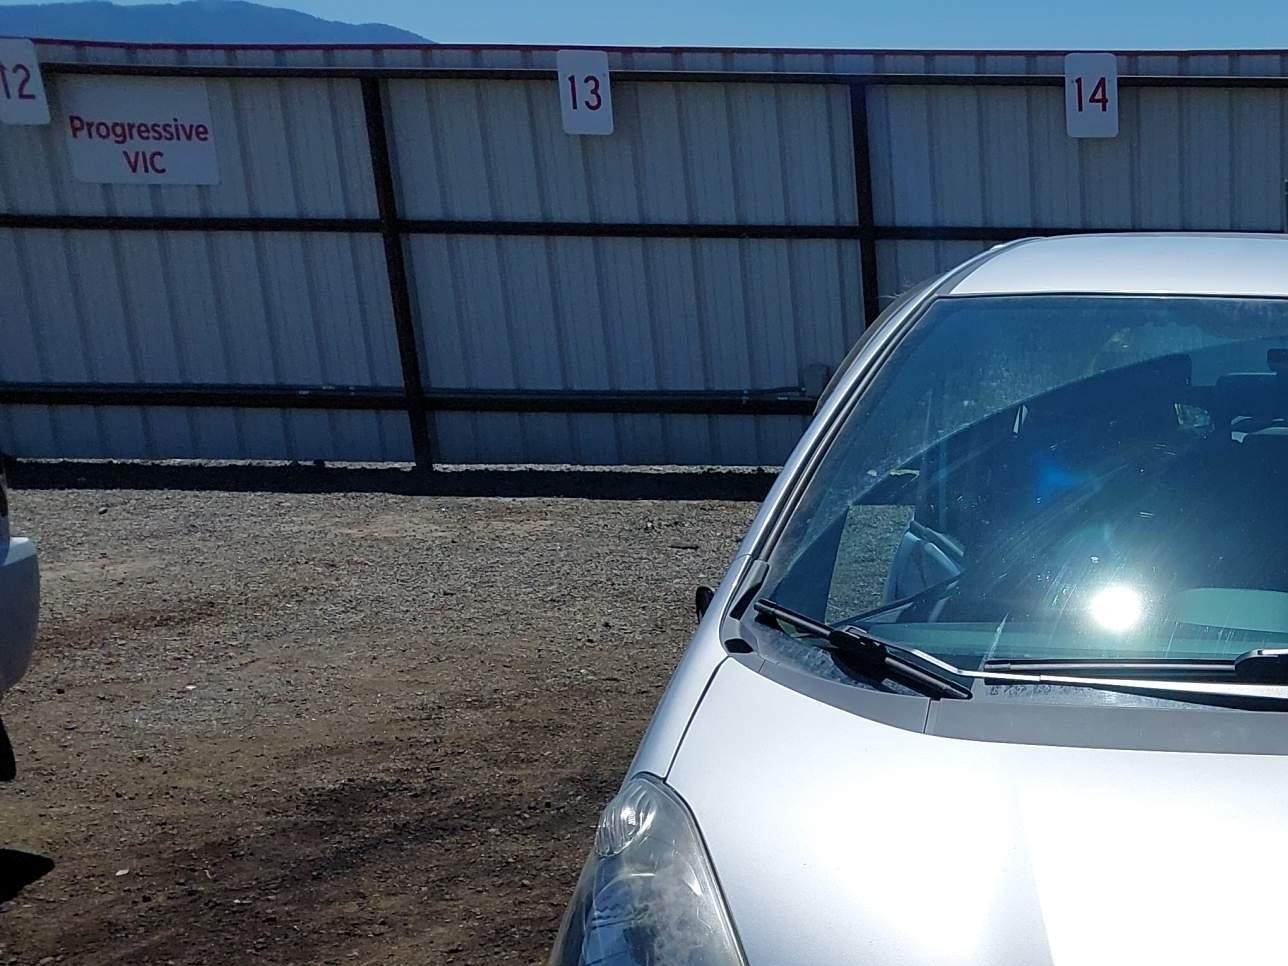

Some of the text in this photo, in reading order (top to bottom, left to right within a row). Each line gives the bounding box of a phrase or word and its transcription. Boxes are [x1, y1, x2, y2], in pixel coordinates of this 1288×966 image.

[0, 63, 36, 100] 12
[567, 75, 602, 111] 13
[1075, 76, 1109, 112] 14
[68, 115, 209, 145] Progressive
[122, 150, 167, 174] VIC
